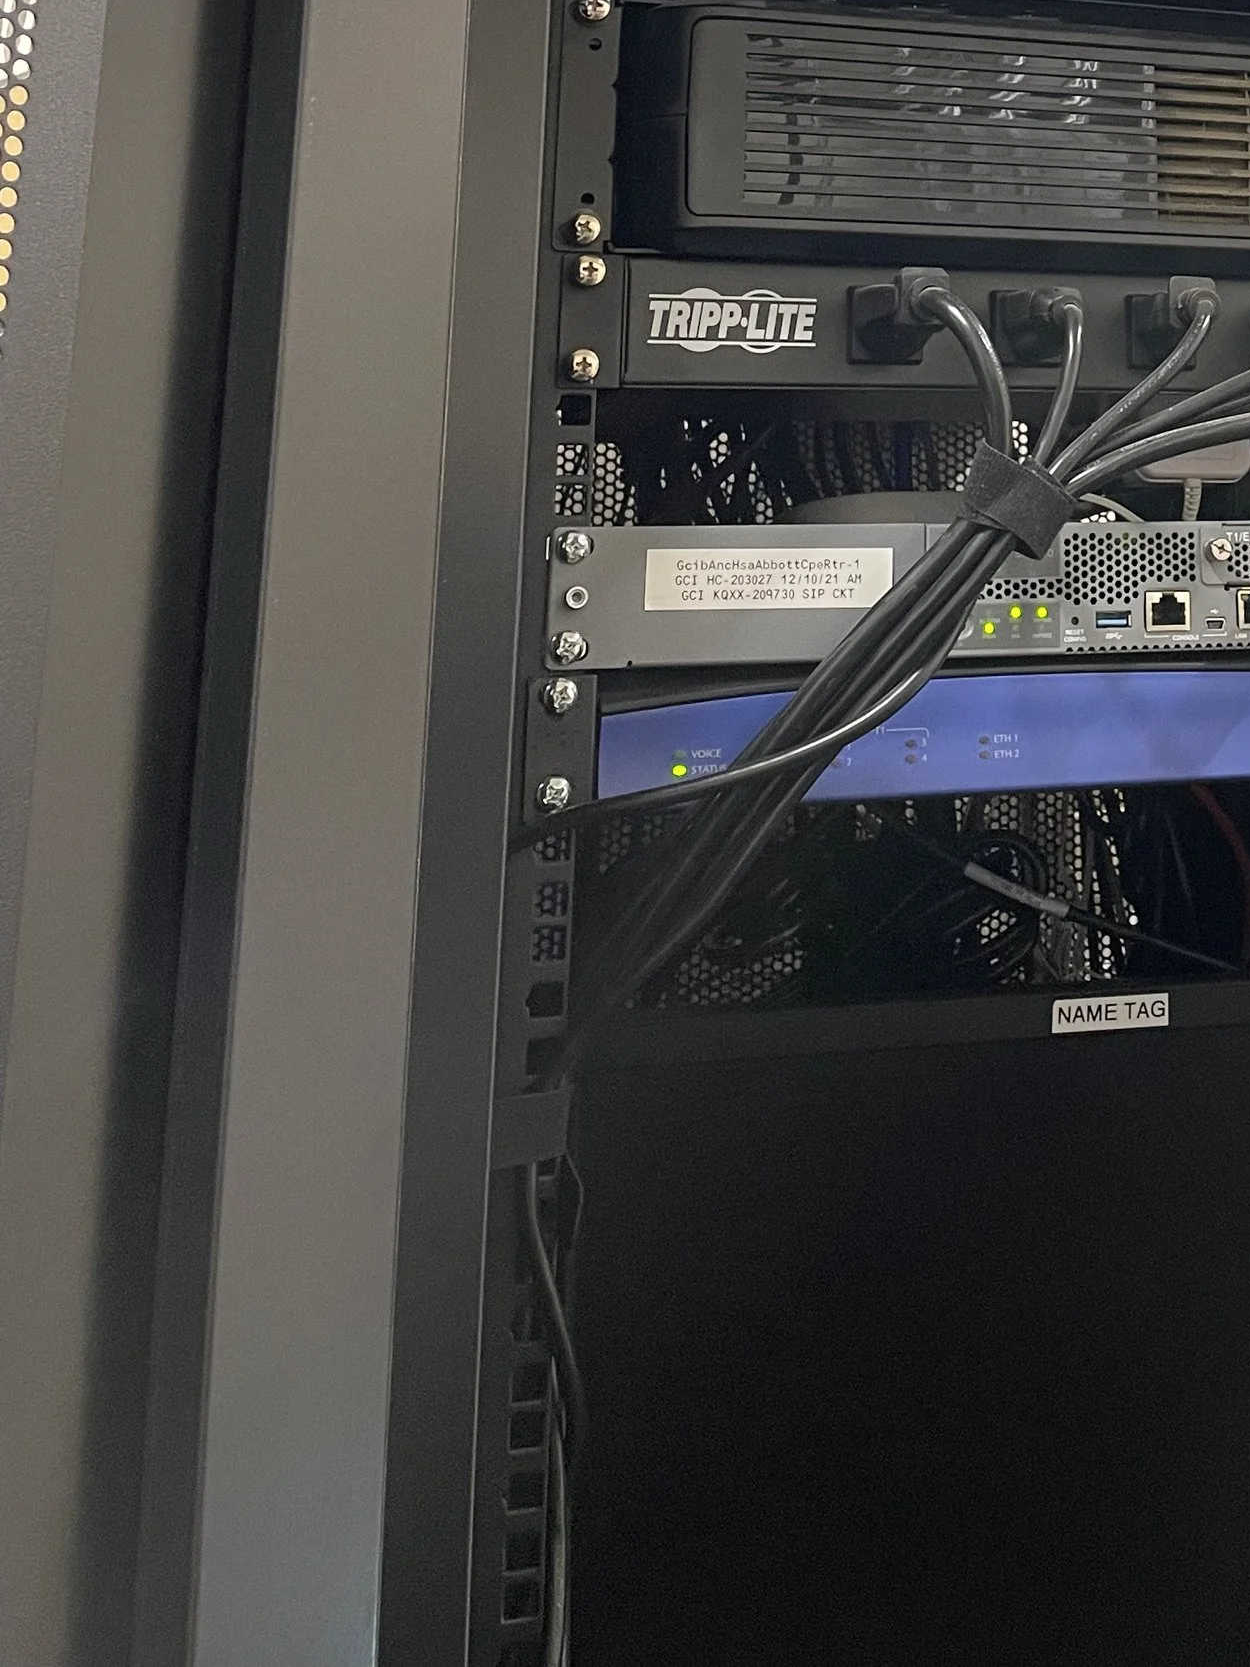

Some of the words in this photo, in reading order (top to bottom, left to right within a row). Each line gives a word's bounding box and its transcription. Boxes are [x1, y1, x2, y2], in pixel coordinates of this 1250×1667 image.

[676, 559, 861, 572] GcibAncHsaAbbottCpeRtr-1
[675, 575, 697, 586] GCI
[706, 574, 772, 586] HC-203027
[780, 574, 839, 585] 12/10/21
[847, 574, 862, 584] AM
[681, 590, 704, 601] GCI
[802, 588, 825, 600] SIP
[832, 588, 855, 600] CKT
[994, 734, 1012, 743] ETH
[691, 748, 722, 759] VOICE
[994, 750, 1013, 759] ETH
[1058, 1003, 1118, 1025] NAME
[1123, 1000, 1166, 1020] TAG
